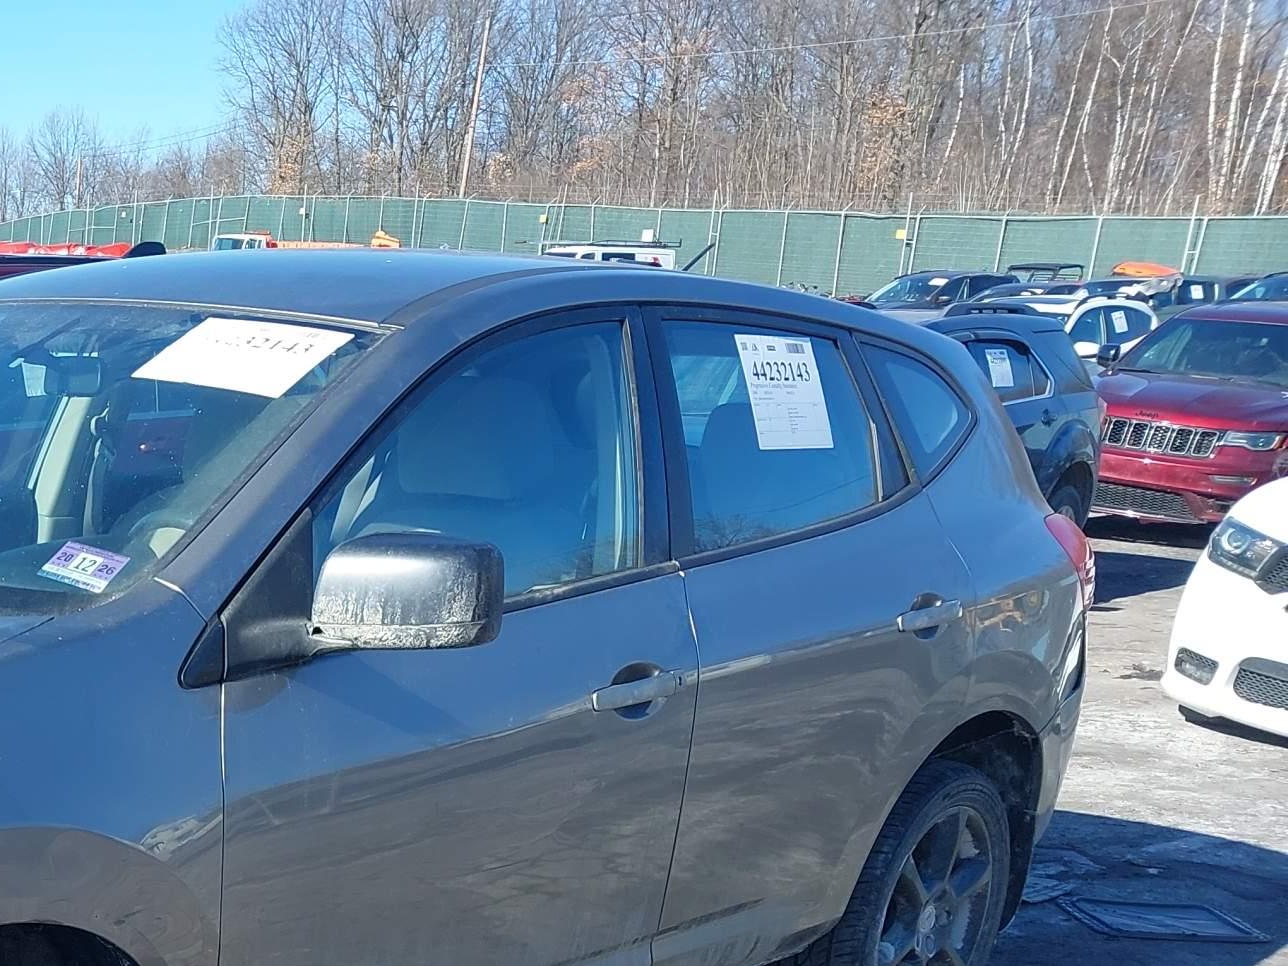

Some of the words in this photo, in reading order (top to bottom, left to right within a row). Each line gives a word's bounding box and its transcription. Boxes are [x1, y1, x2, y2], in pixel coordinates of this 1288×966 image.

[752, 360, 811, 382] 44232143
[56, 551, 74, 562] 20
[73, 556, 97, 572] 12
[97, 564, 117, 576] 26
